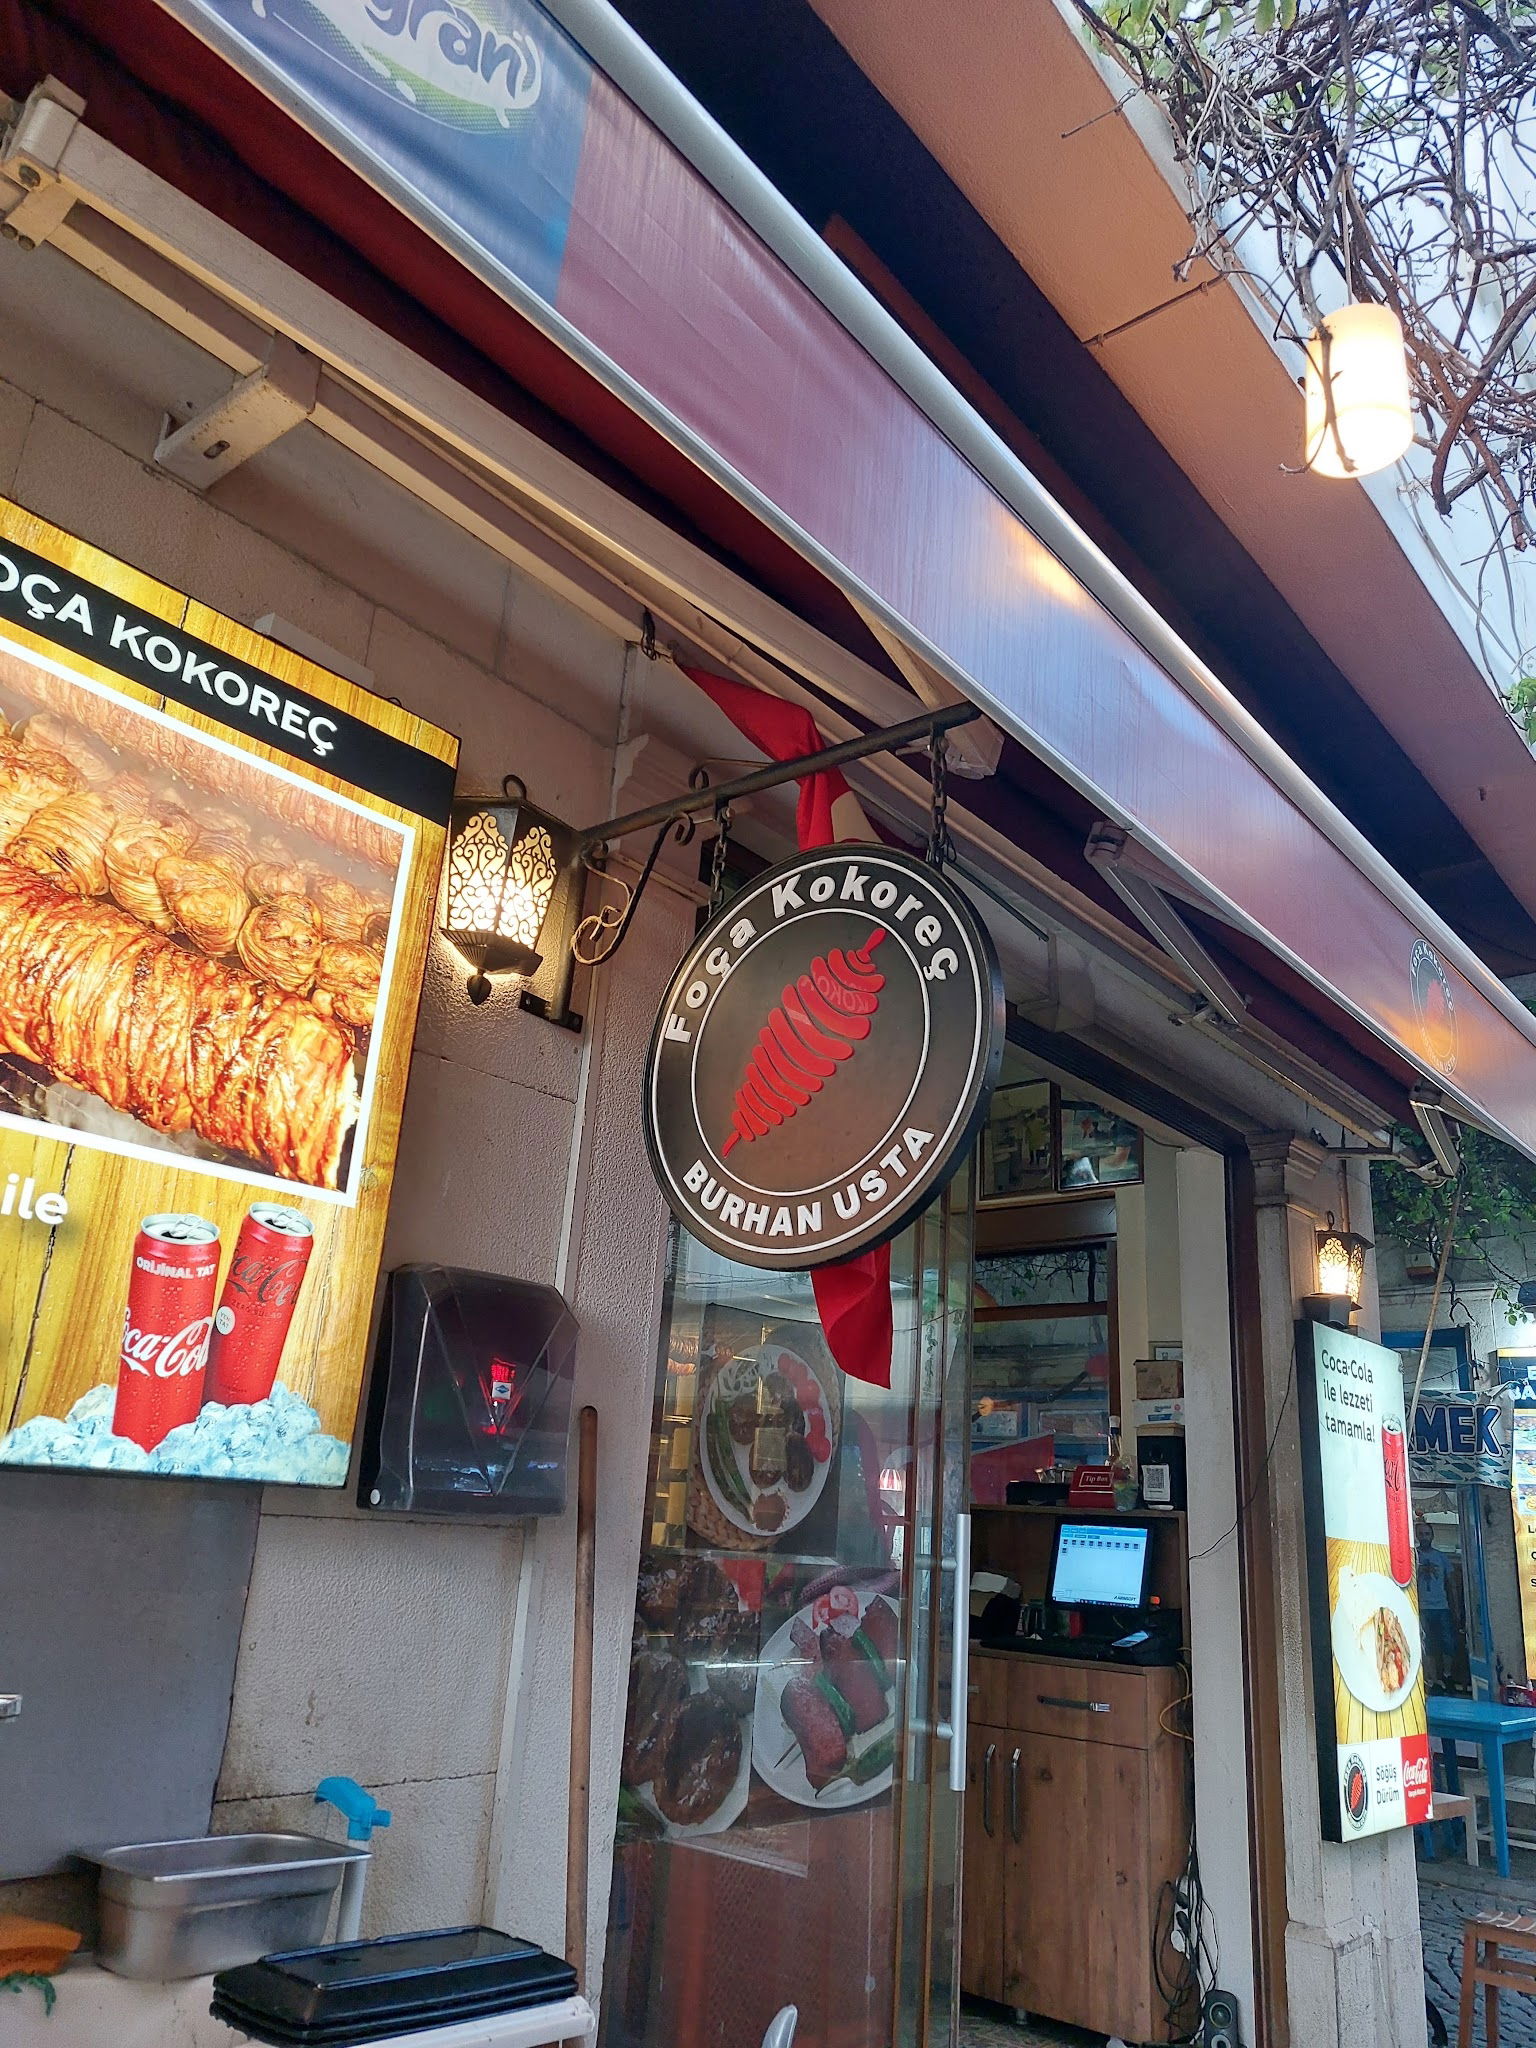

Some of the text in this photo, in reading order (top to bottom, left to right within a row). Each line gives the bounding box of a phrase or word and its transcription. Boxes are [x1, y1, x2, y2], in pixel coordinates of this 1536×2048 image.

[109, 614, 338, 757] KOKOREÇ
[664, 865, 959, 1044] Foça Kokoreç
[682, 1126, 935, 1236] BURHAN USTA
[1, 1172, 69, 1225] ile
[196, 1264, 216, 1278] TAT
[1323, 1378, 1373, 1413] ile lezzeti
[1325, 1411, 1376, 1443] tamamla!
[1085, 1475, 1096, 1484] Tip
[1376, 1764, 1397, 1783] Söğüş
[1376, 1787, 1400, 1805] Dürüm
